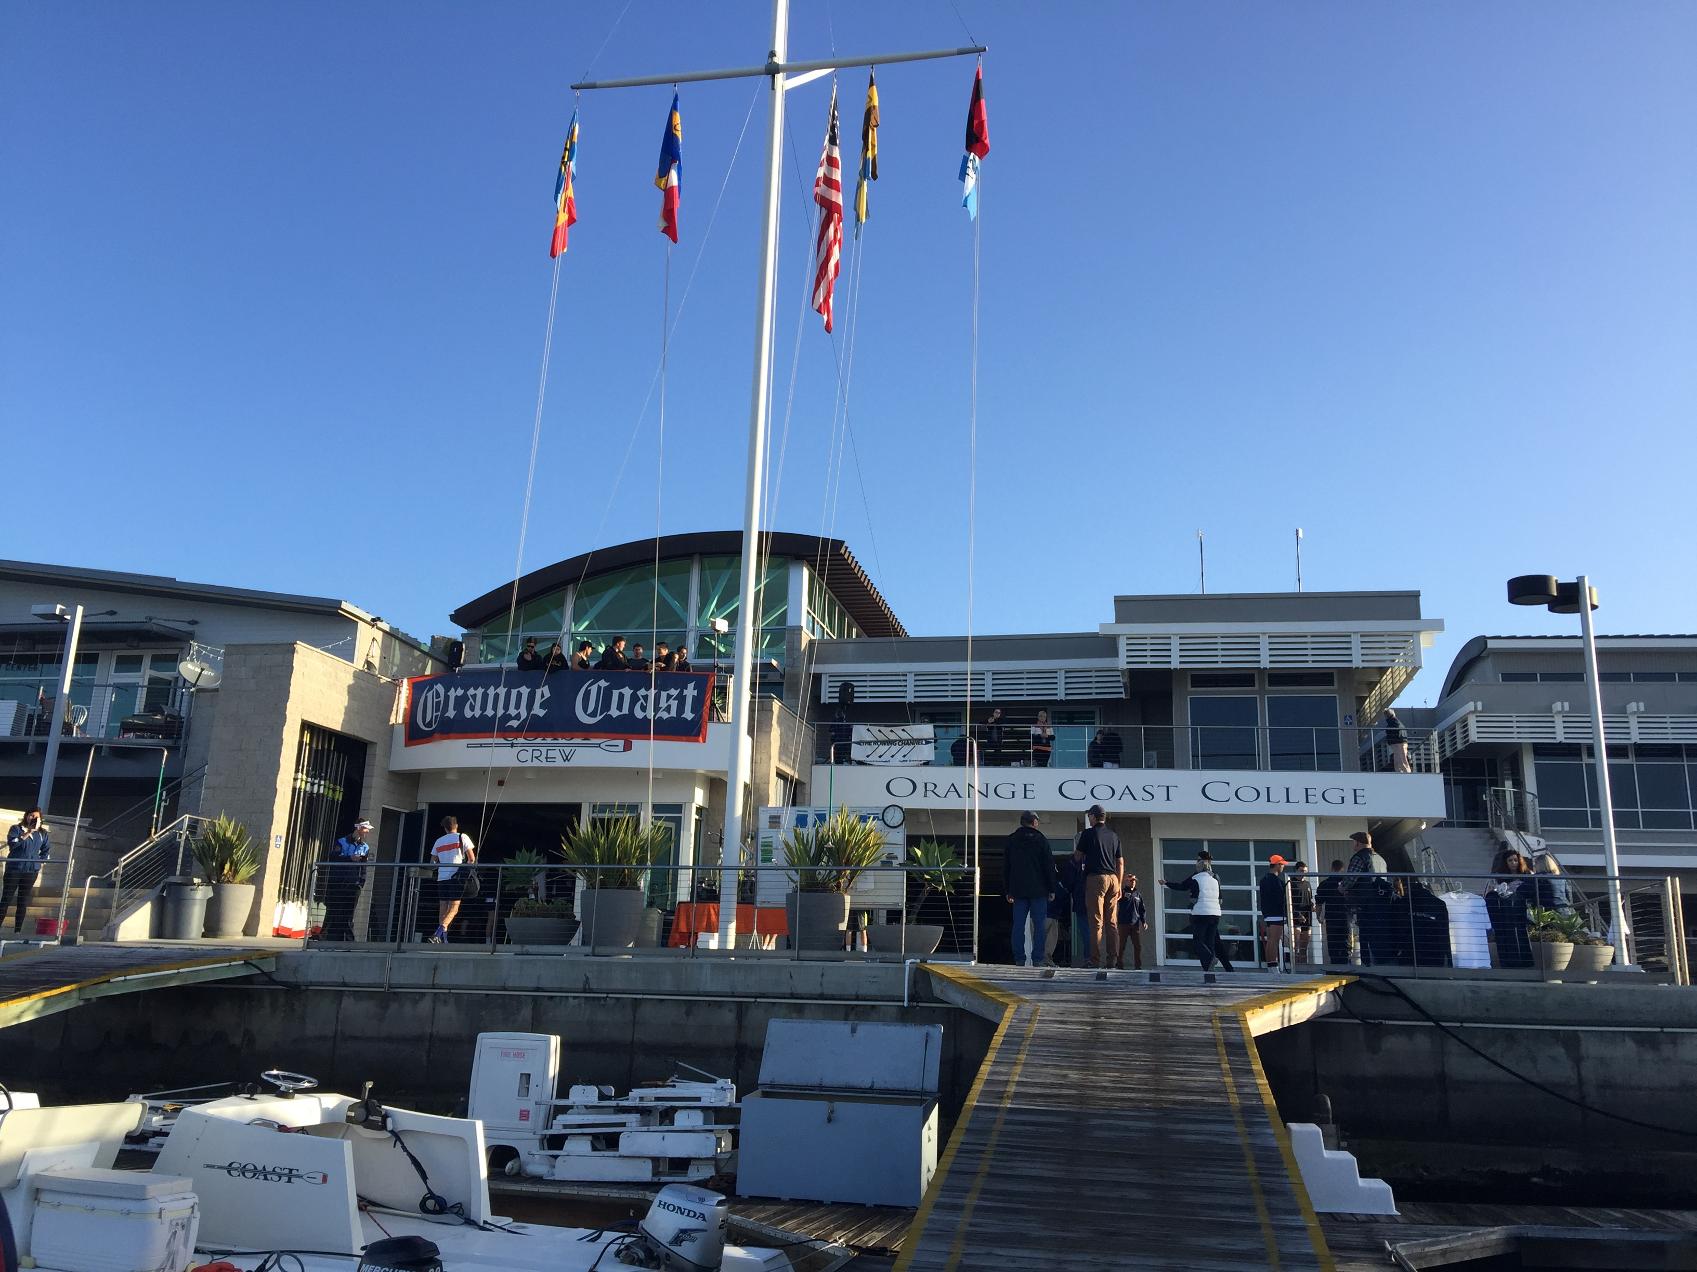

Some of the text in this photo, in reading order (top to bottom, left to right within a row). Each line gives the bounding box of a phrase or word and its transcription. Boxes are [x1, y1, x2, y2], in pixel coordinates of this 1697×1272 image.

[416, 678, 698, 731] Orange Coast
[516, 748, 577, 763] CREW
[885, 776, 1367, 805] ORANGE COAST COLLEGE
[226, 1161, 299, 1184] COAST
[656, 1199, 707, 1223] HONDA
